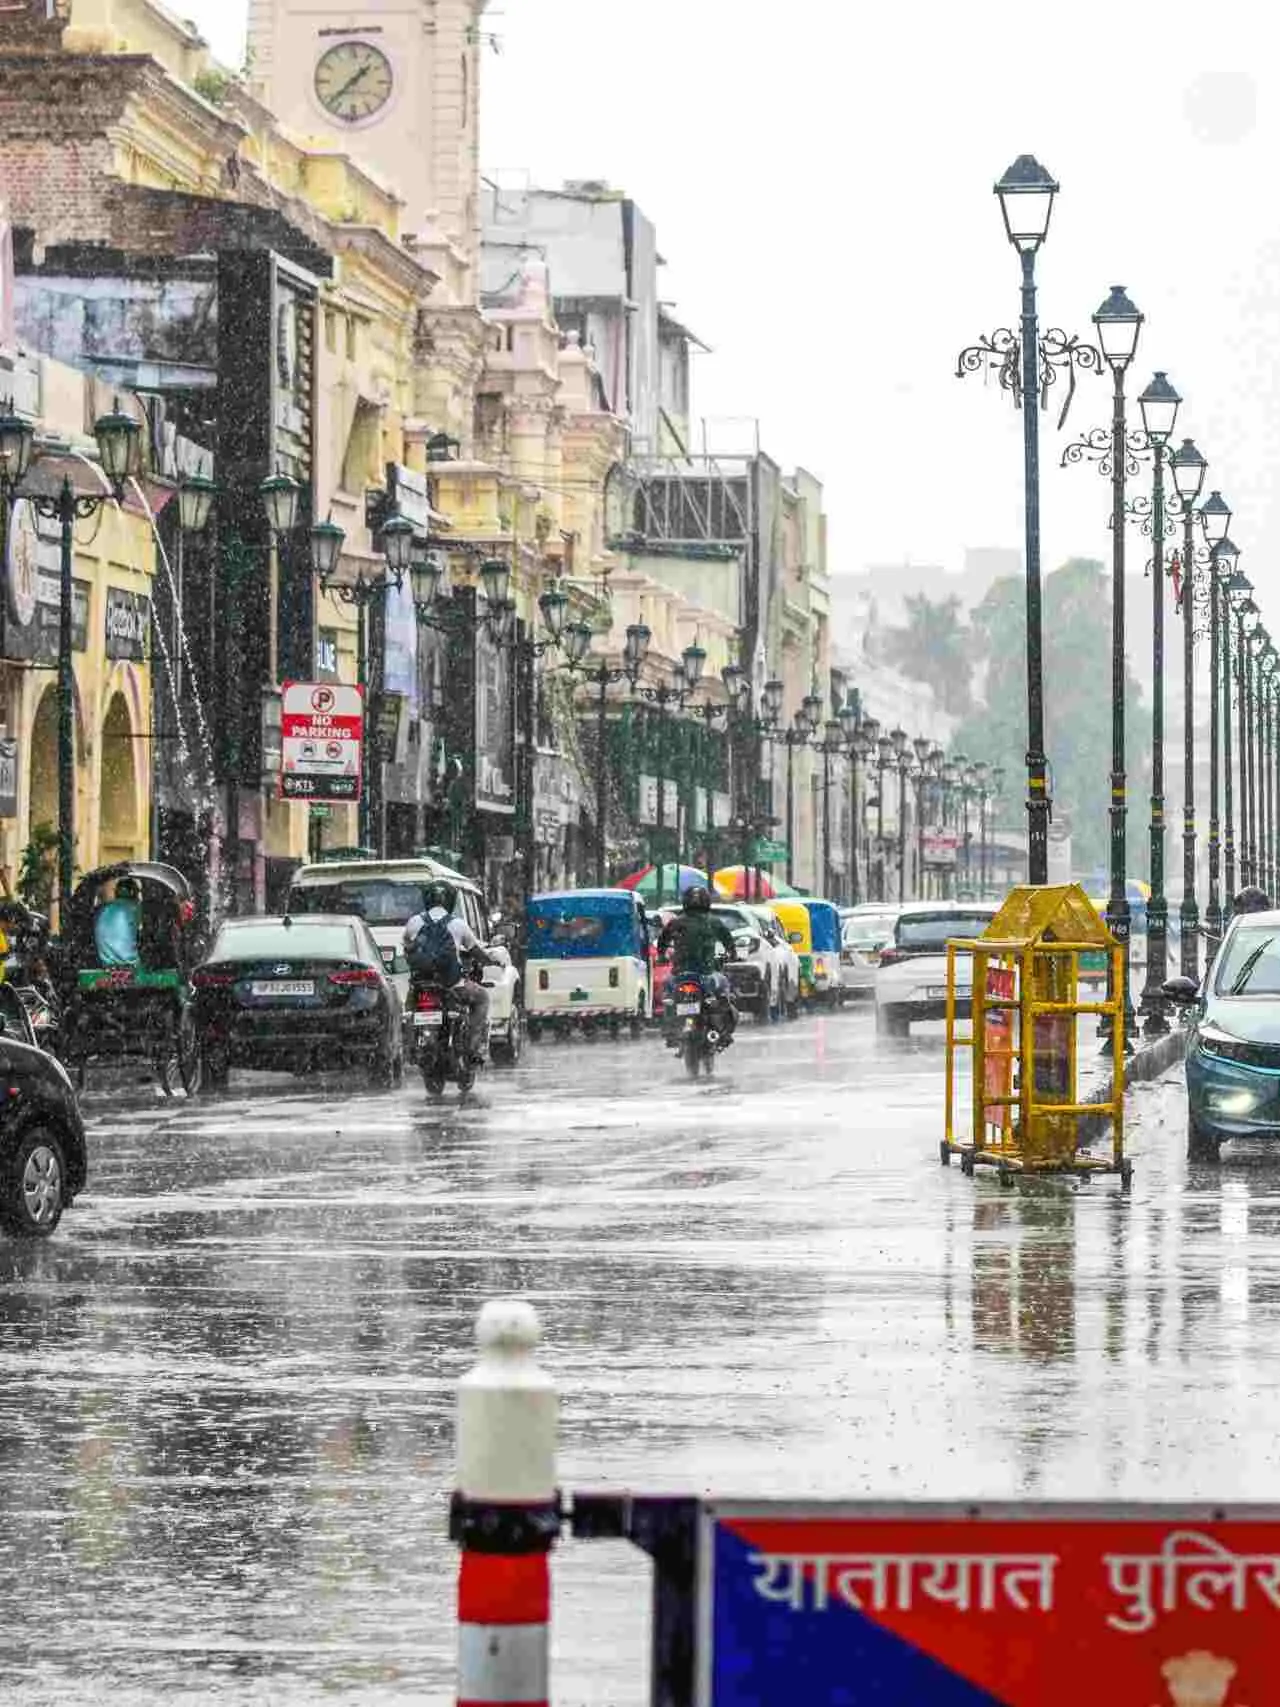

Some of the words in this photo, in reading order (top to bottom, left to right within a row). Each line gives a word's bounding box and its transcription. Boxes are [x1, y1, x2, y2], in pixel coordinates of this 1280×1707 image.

[311, 714, 333, 726] NO
[291, 726, 352, 739] PARKING
[747, 1552, 1060, 1613] यातायात
